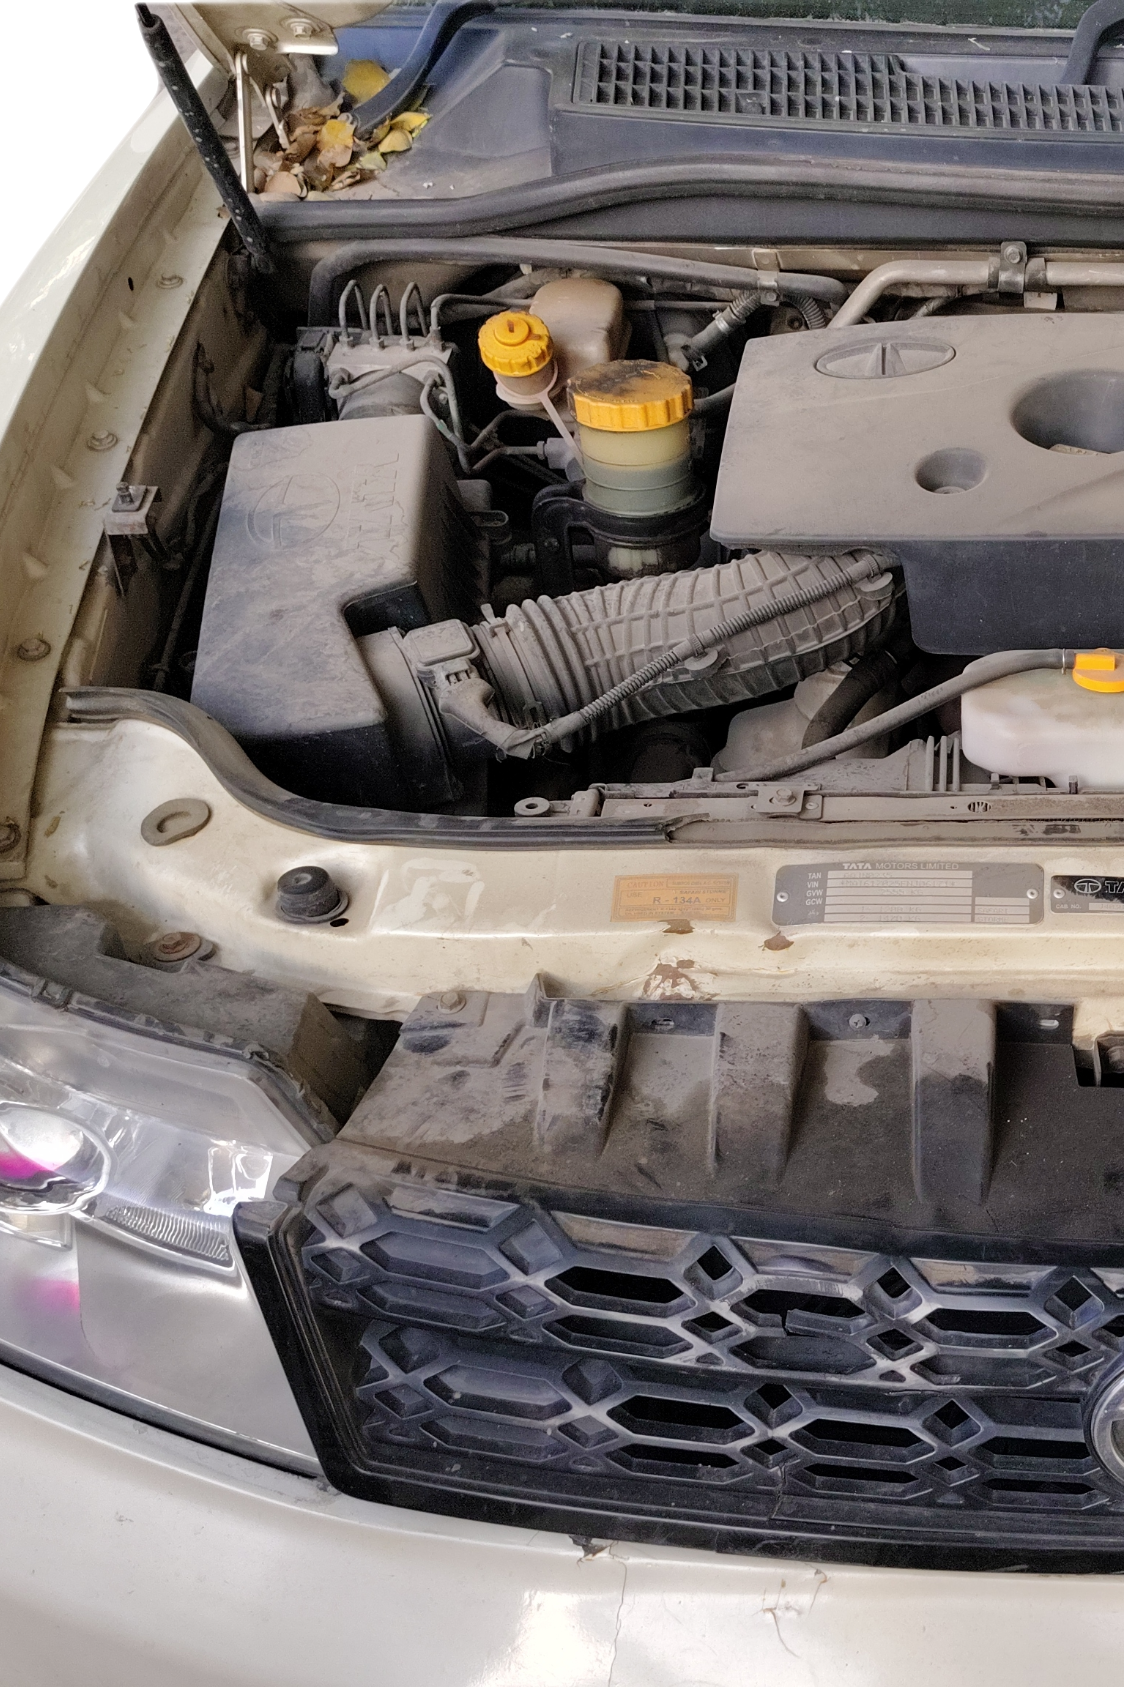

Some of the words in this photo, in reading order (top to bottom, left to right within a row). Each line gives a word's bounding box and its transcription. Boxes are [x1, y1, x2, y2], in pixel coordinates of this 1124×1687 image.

[842, 862, 872, 870] TATA
[875, 862, 918, 870] MOTORS
[920, 862, 959, 870] LIMITED
[808, 872, 822, 880] TAN
[627, 880, 664, 889] CAUTION
[807, 881, 819, 889] VIN
[806, 889, 824, 897] GVW
[805, 898, 824, 906] GCW
